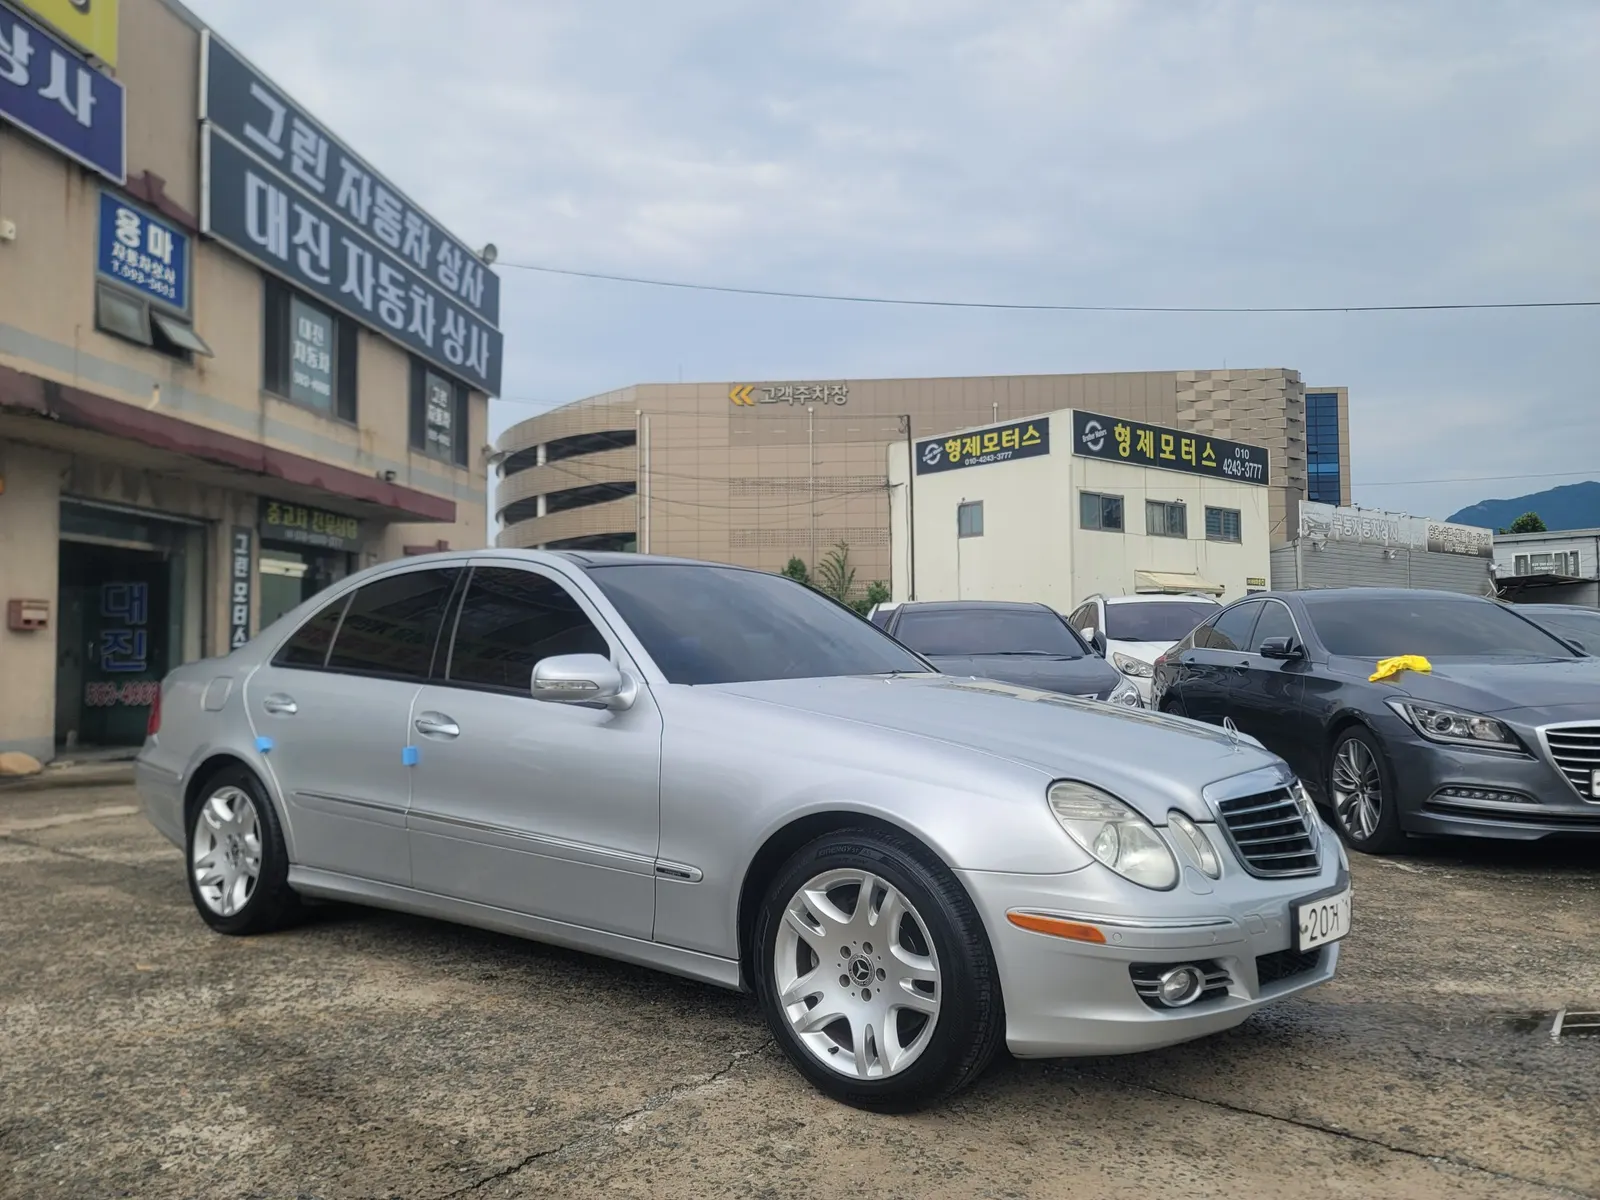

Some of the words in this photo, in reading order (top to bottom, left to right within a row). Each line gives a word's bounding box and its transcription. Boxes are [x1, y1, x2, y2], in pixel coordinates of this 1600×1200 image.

[243, 82, 329, 193] 그린
[336, 155, 431, 270] 자동차
[436, 240, 485, 308] 상사
[245, 169, 331, 285] 대진
[340, 236, 436, 348] 자동차
[441, 307, 489, 379] 상사
[760, 384, 849, 406] 고객주차장
[945, 424, 1041, 462] 형제모터스
[964, 451, 1013, 466] 010-4243-3777
[1113, 423, 1216, 467] 형제모터스
[1235, 447, 1250, 460] 010
[1222, 458, 1263, 480] 4243-3777
[102, 583, 148, 671] 대진
